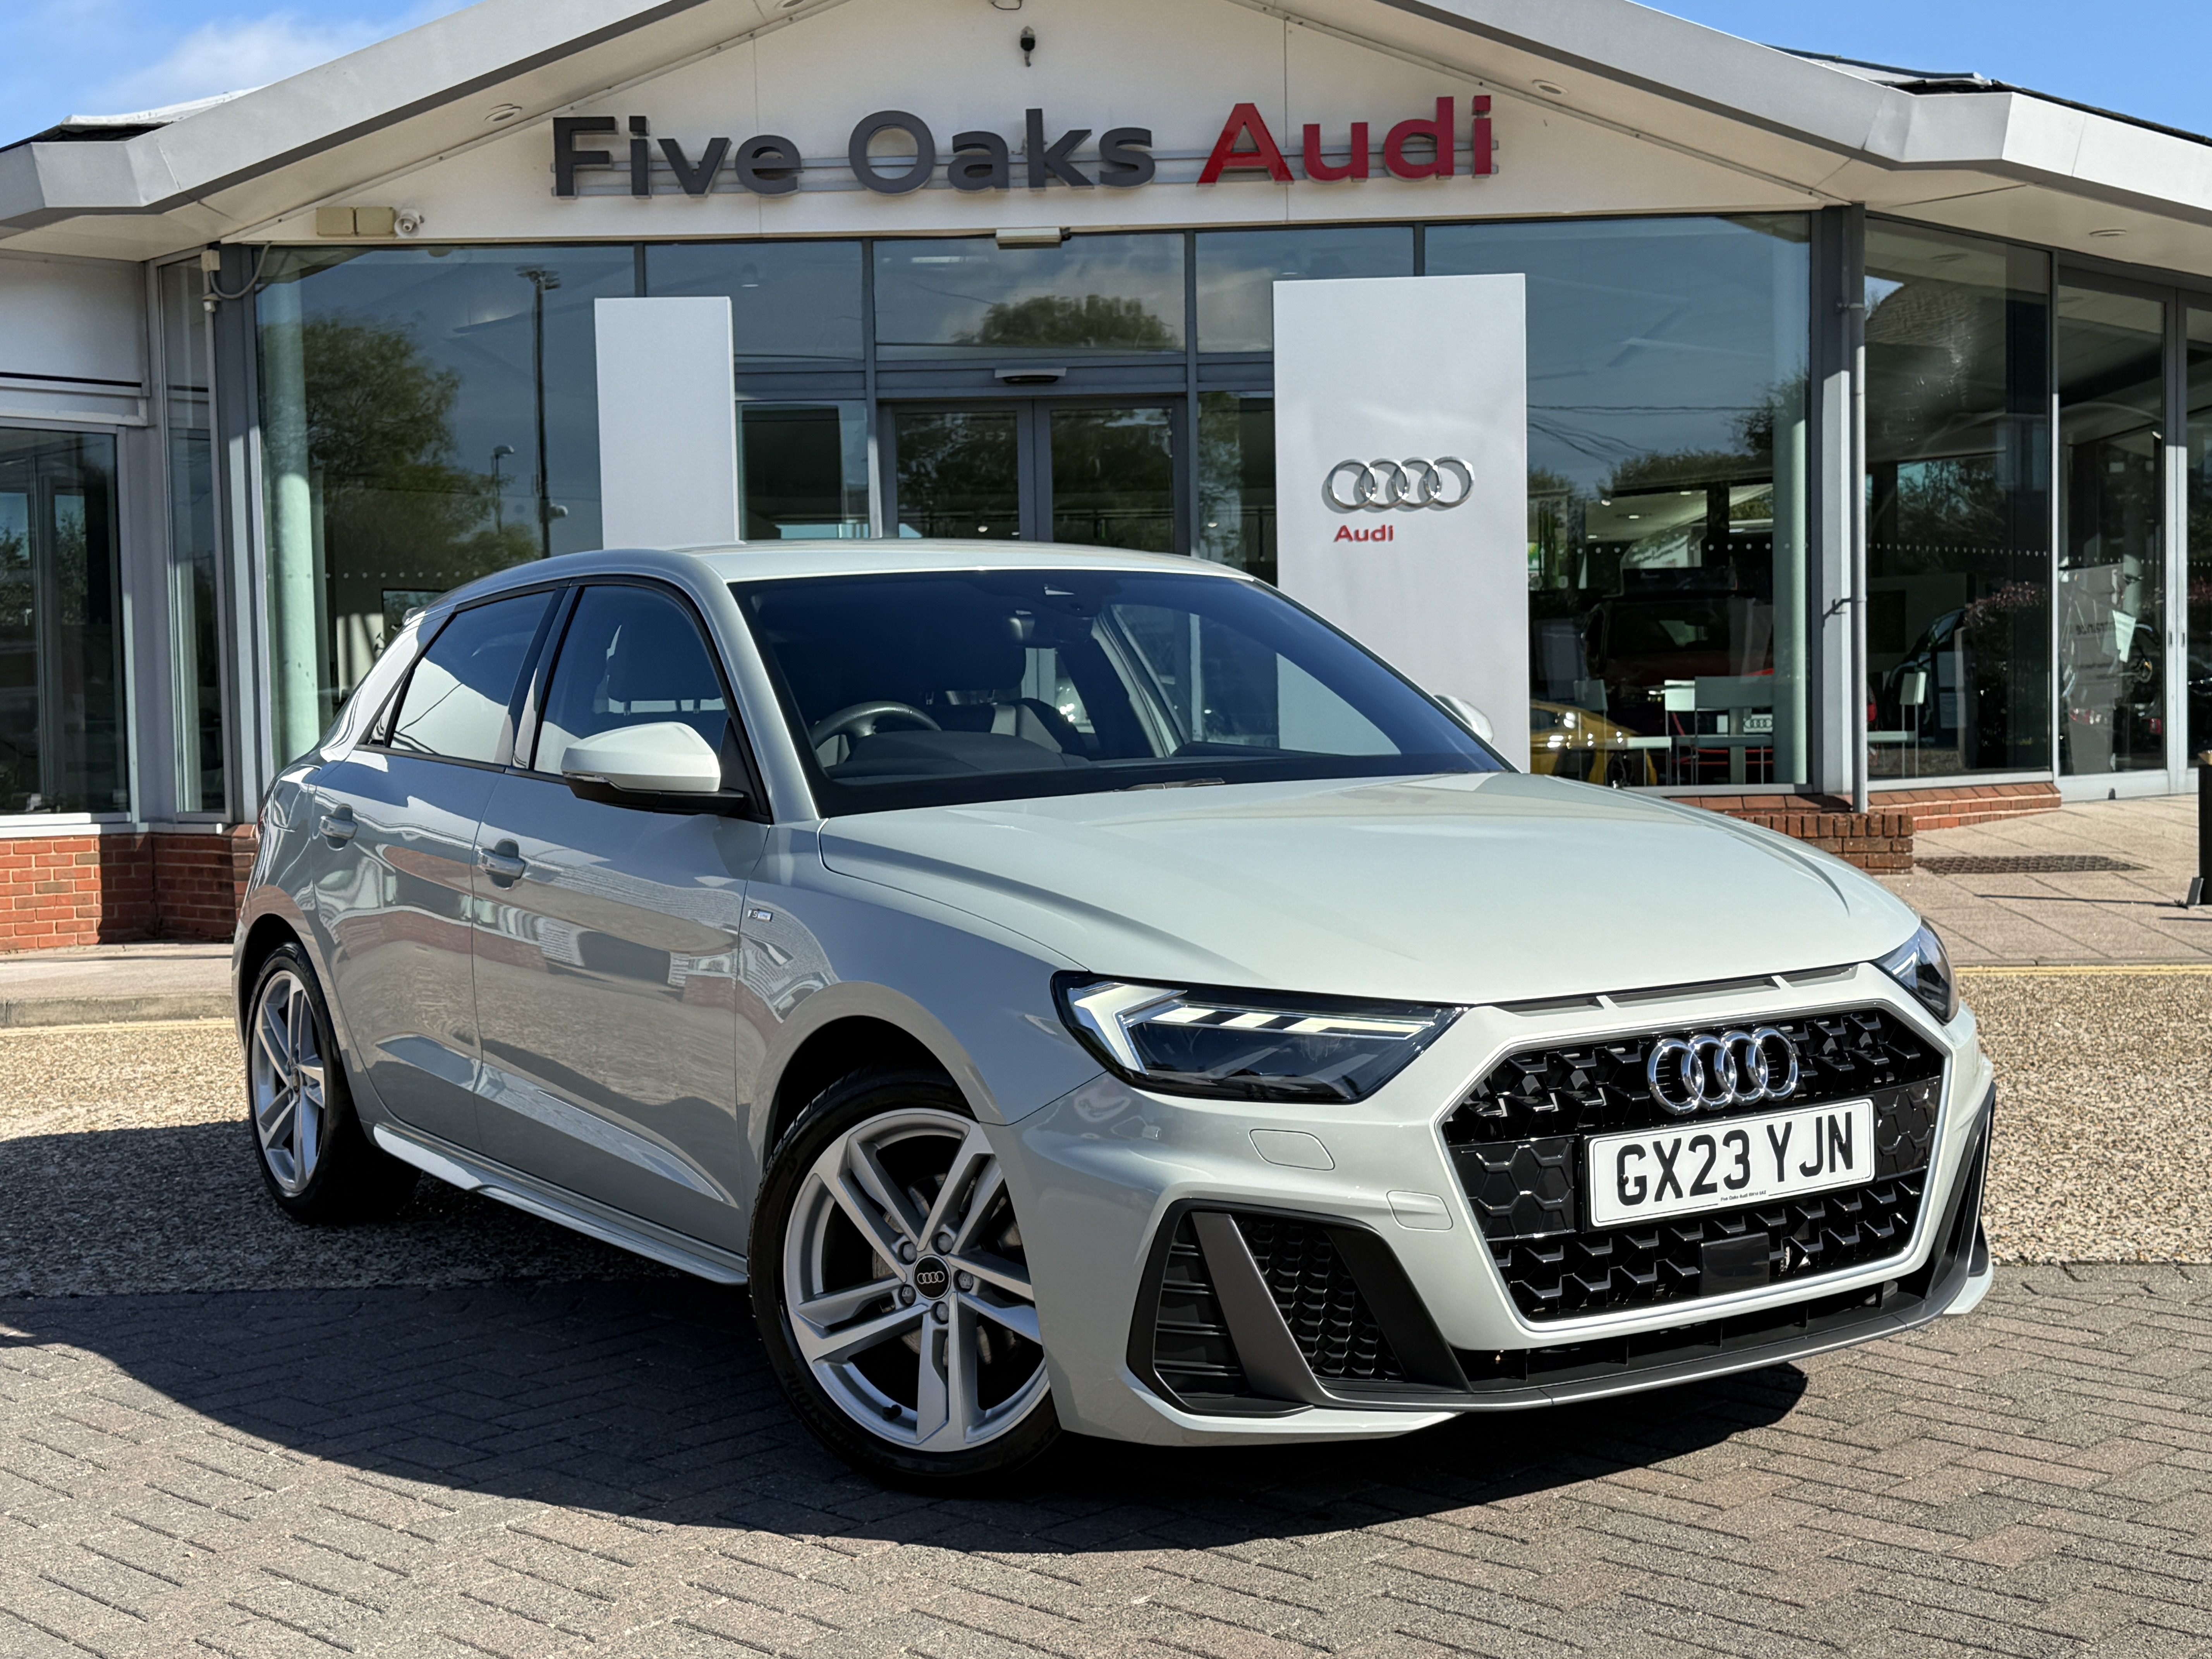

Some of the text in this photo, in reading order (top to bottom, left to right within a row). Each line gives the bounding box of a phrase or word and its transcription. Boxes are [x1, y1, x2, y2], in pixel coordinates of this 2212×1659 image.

[553, 95, 1492, 198] Five Oaks Audi
[1333, 524, 1394, 542] Audi
[1617, 1111, 1853, 1206] GX23 YJN
